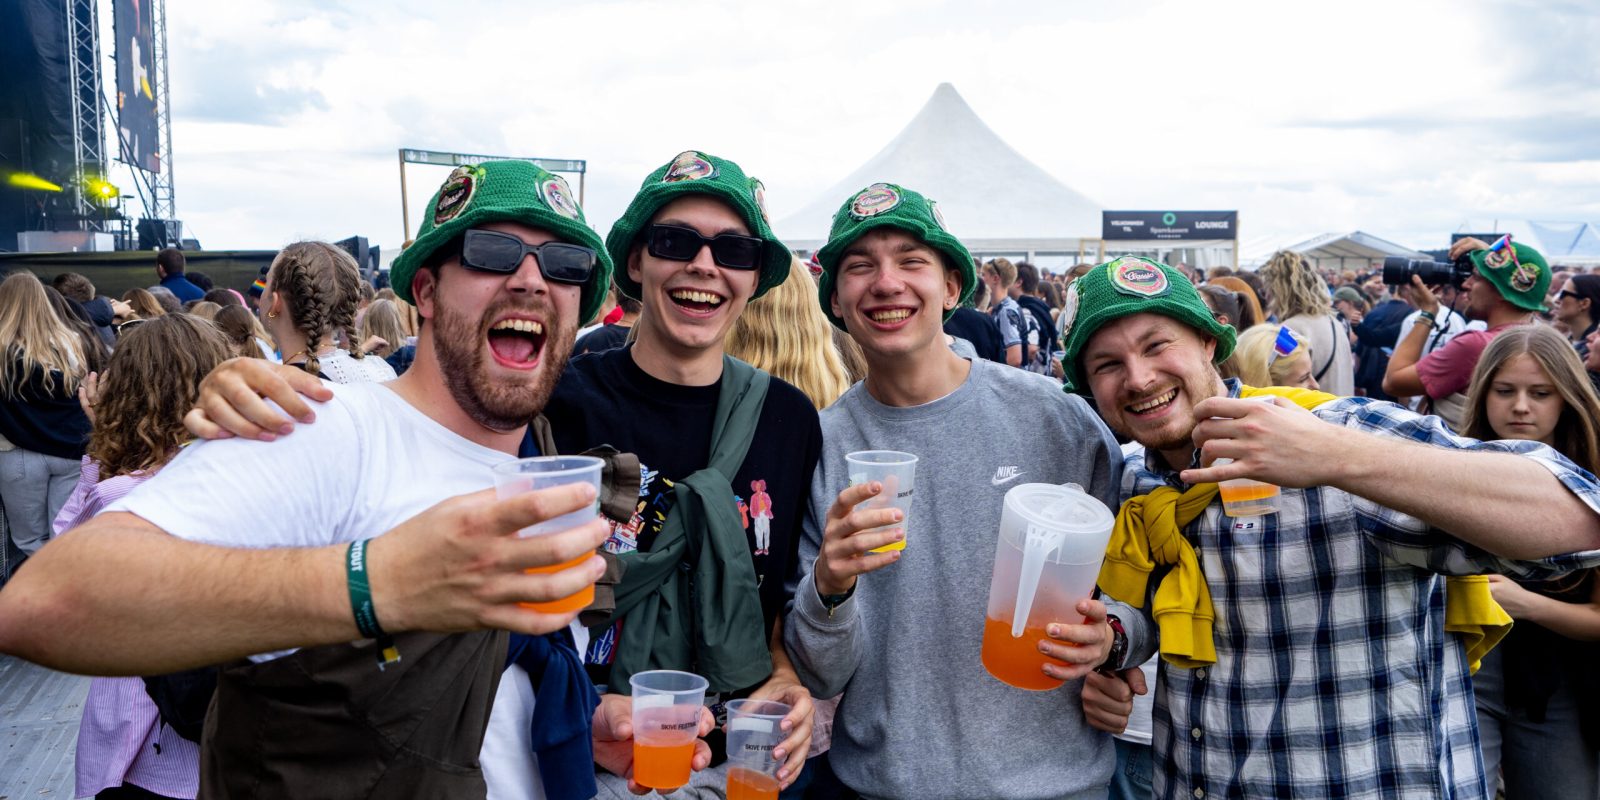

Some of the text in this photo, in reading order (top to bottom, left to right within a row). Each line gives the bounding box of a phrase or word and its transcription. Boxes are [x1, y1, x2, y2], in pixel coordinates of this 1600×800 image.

[1195, 221, 1229, 229] LOUNGE
[1124, 271, 1155, 281] Classic
[997, 466, 1018, 477] NIKE
[745, 743, 760, 751] SKIVE
